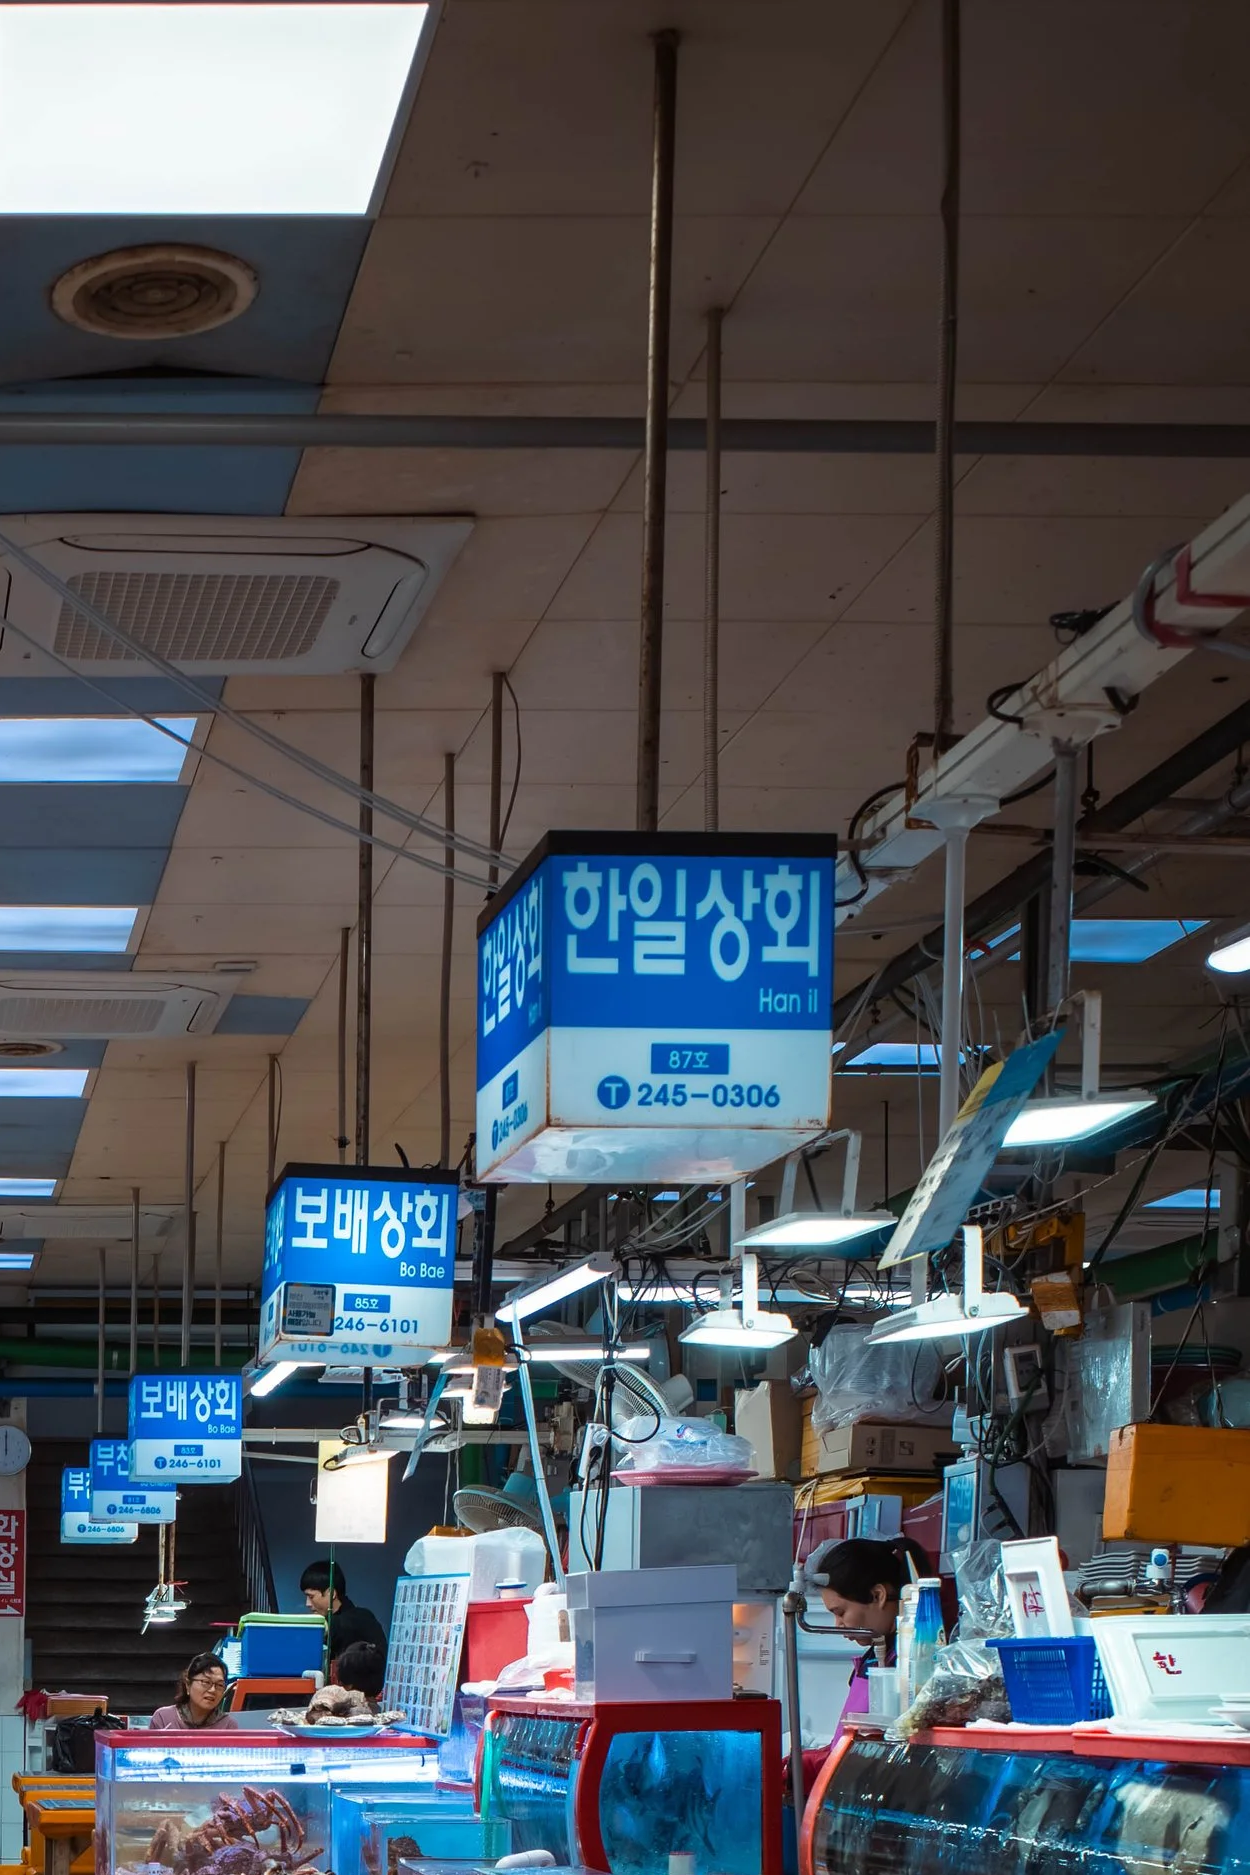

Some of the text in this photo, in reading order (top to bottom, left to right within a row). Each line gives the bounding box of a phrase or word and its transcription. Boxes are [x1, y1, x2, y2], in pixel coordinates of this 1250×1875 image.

[562, 862, 819, 982] 한일상회
[483, 875, 543, 1038] 한일상회
[759, 988, 818, 1014] Han il
[668, 1050, 710, 1069] 87호
[637, 1083, 781, 1108] 245-0306
[292, 1187, 449, 1259] 보배상회
[400, 1262, 445, 1279] Bo Bae
[354, 1297, 380, 1310] 85호
[335, 1316, 418, 1334] 246-6101
[141, 1379, 237, 1423] 보배상회
[207, 1424, 236, 1434] Bo Bae
[169, 1459, 221, 1469] 246-6101
[118, 1506, 161, 1515] 246-6806
